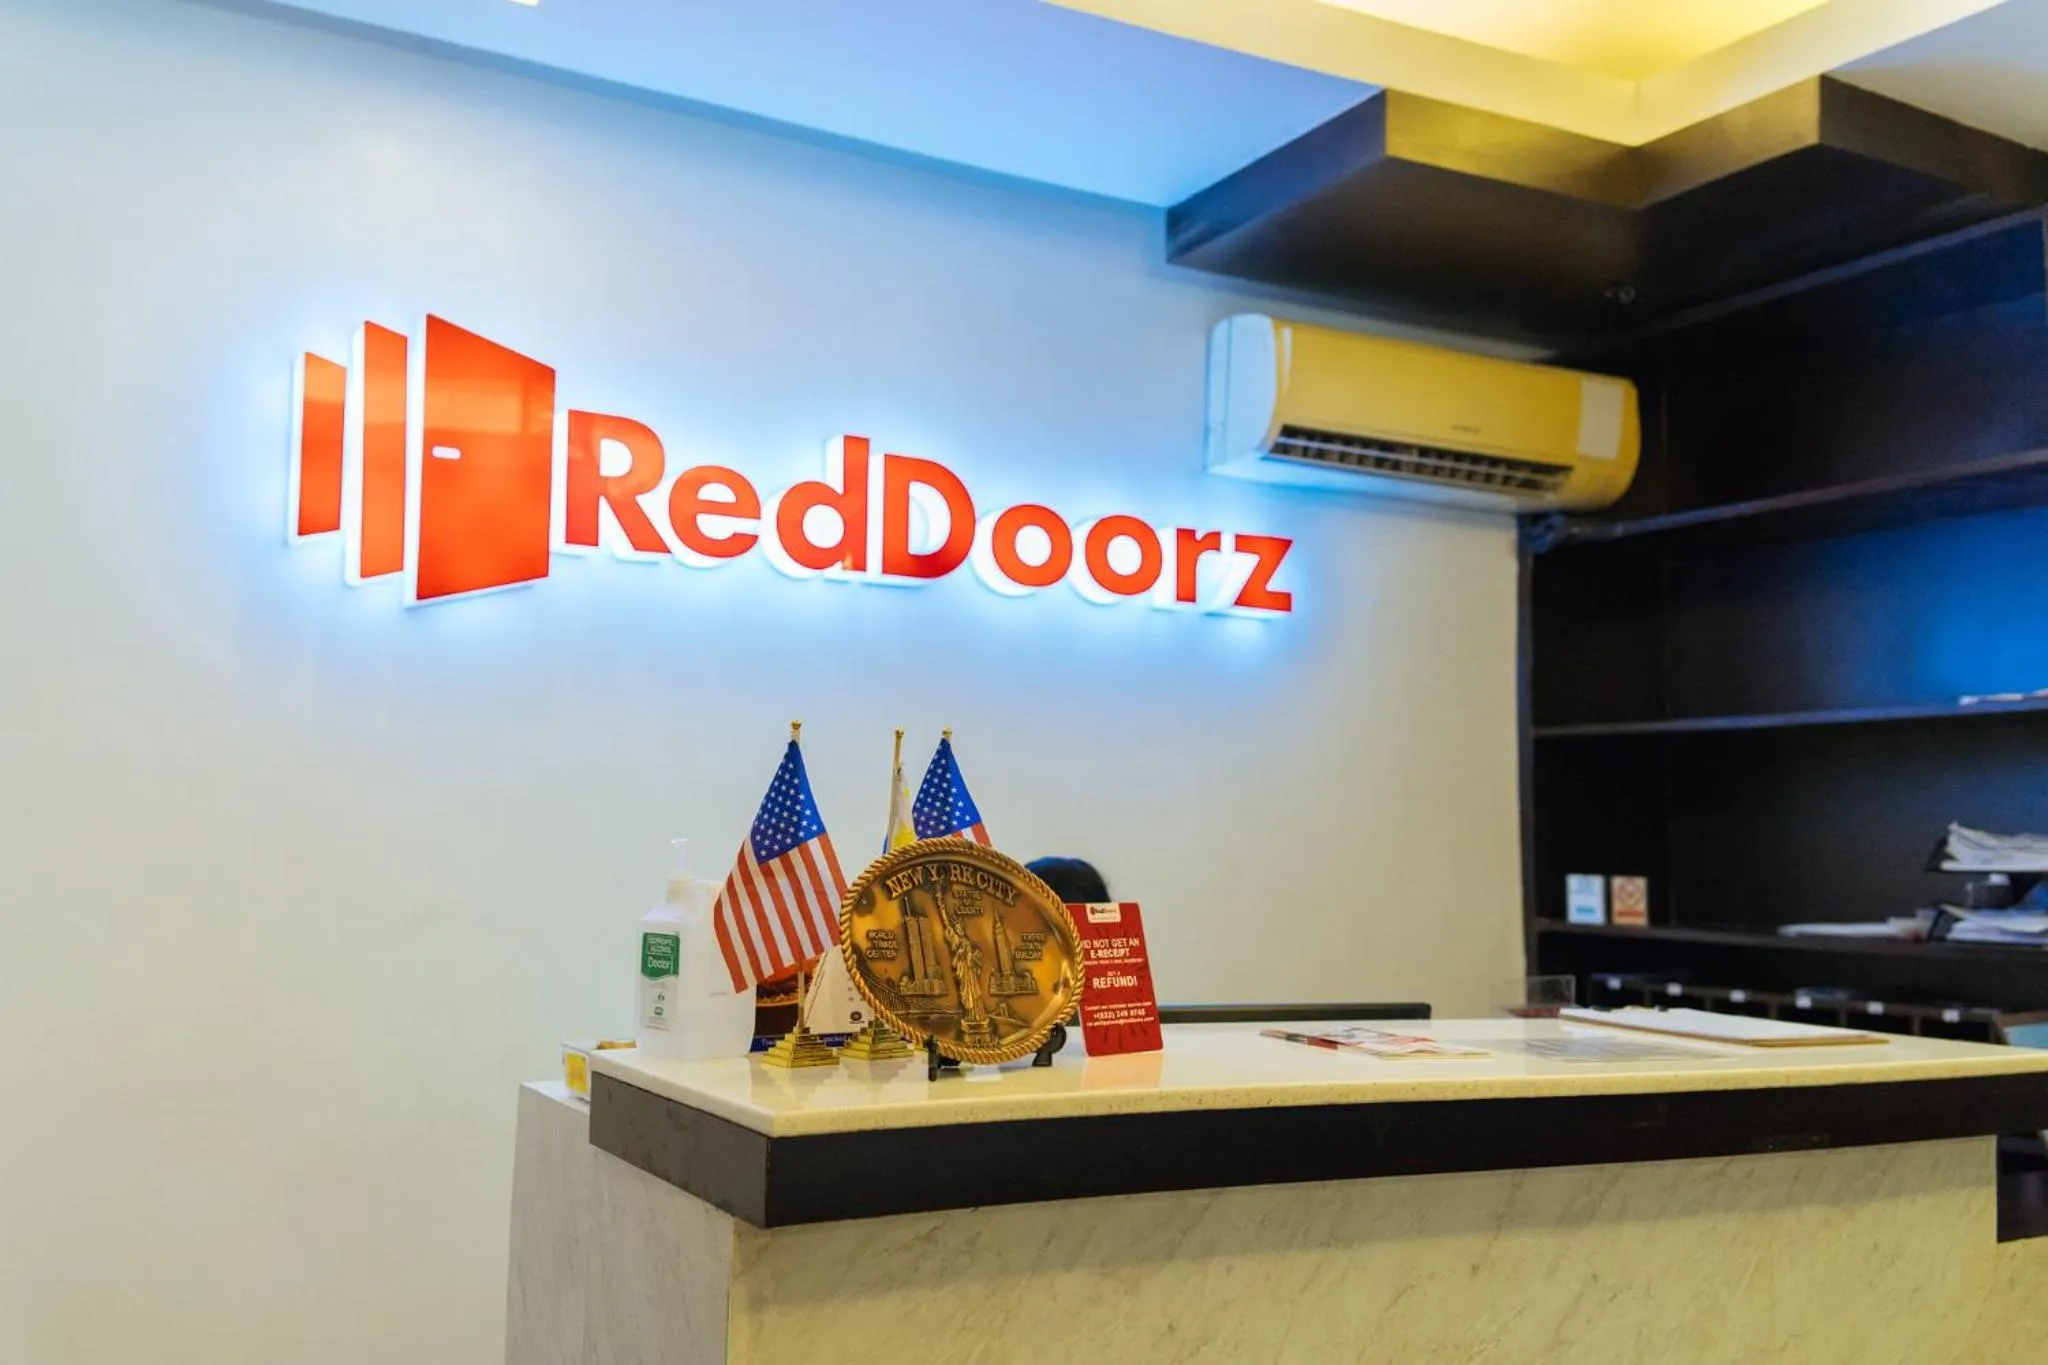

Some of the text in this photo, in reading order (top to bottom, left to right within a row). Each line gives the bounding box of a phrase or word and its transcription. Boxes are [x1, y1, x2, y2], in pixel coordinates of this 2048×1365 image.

[565, 408, 1294, 613] RedDoorz
[886, 865, 924, 898] NEW
[977, 871, 1016, 905] CITY
[1092, 938, 1110, 949] NOT
[1111, 938, 1127, 948] GET
[1128, 936, 1140, 947] AN
[1090, 947, 1130, 959] E-RECEIPT
[1092, 975, 1138, 989] REFUND!
